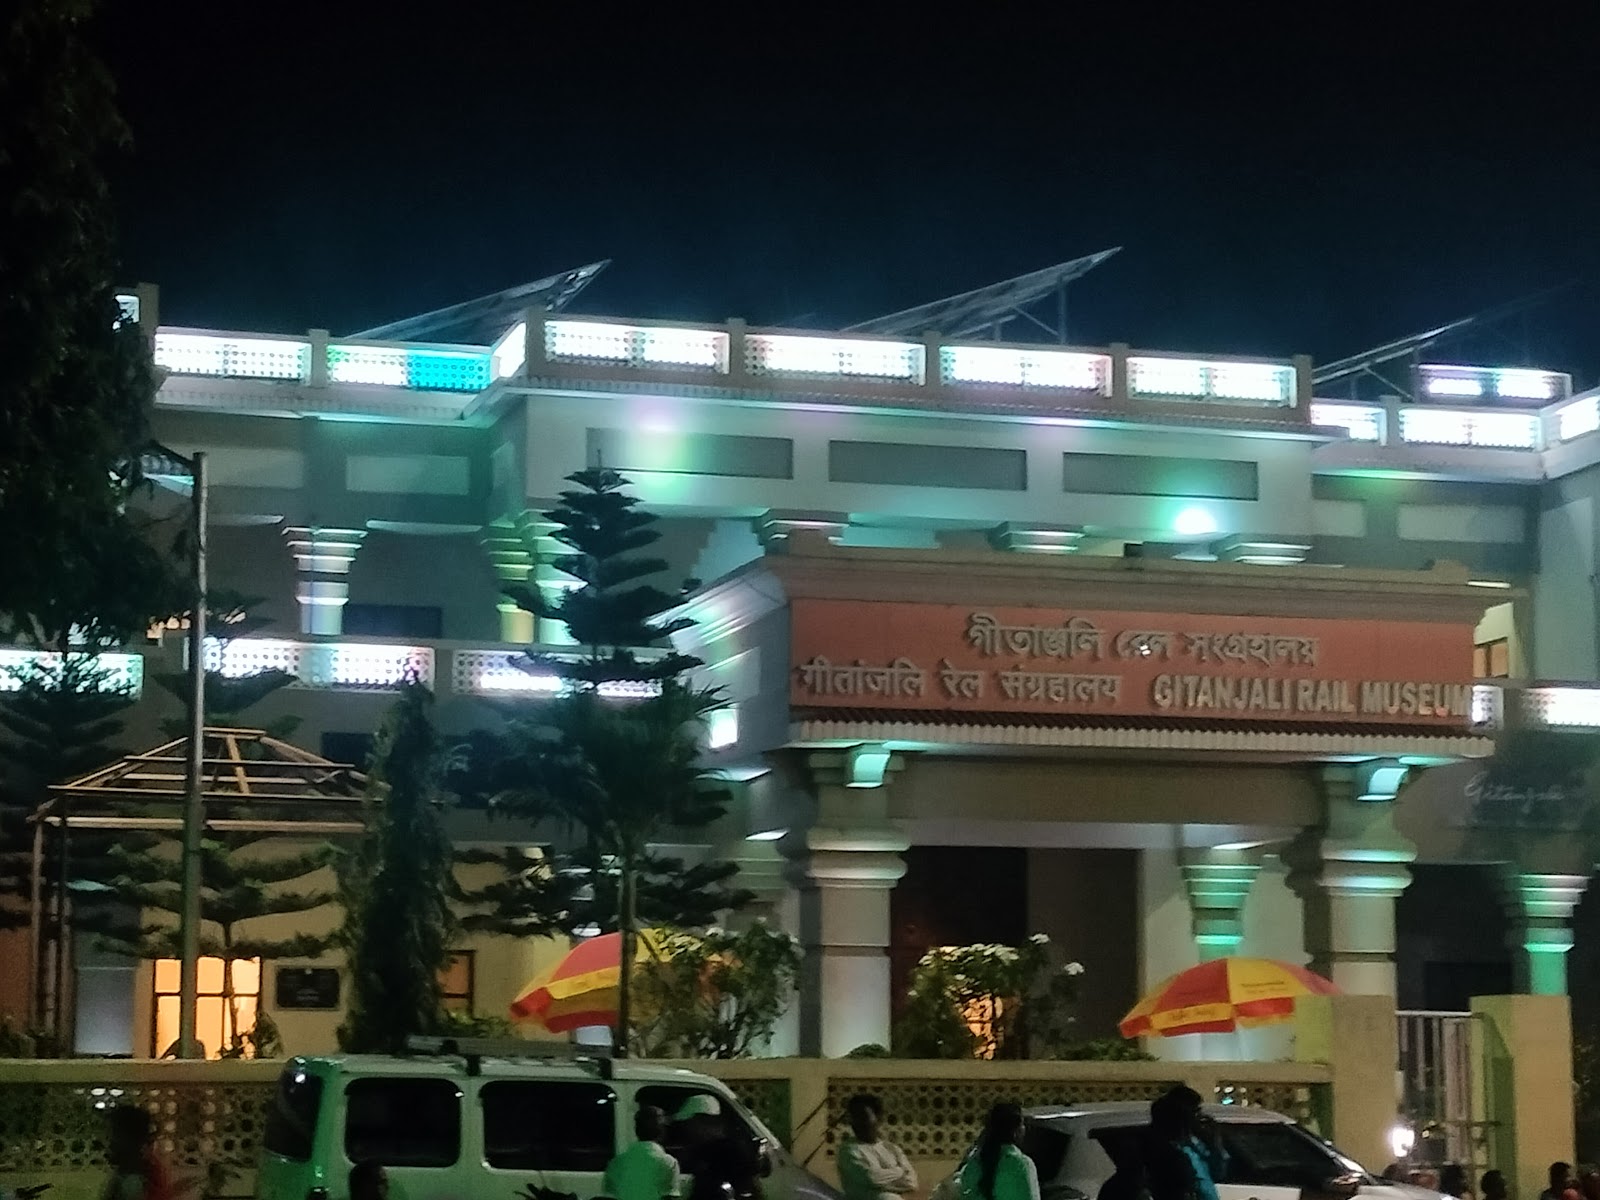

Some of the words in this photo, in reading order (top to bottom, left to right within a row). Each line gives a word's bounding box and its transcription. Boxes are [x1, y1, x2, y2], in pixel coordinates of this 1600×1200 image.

[797, 655, 928, 698] गीतांजलि
[940, 658, 985, 699] रेल
[1001, 664, 1123, 704] संग्रहालय
[1153, 674, 1291, 711] GITANJALI
[1296, 679, 1355, 713] RAIL
[1360, 681, 1473, 716] MUSEUM
